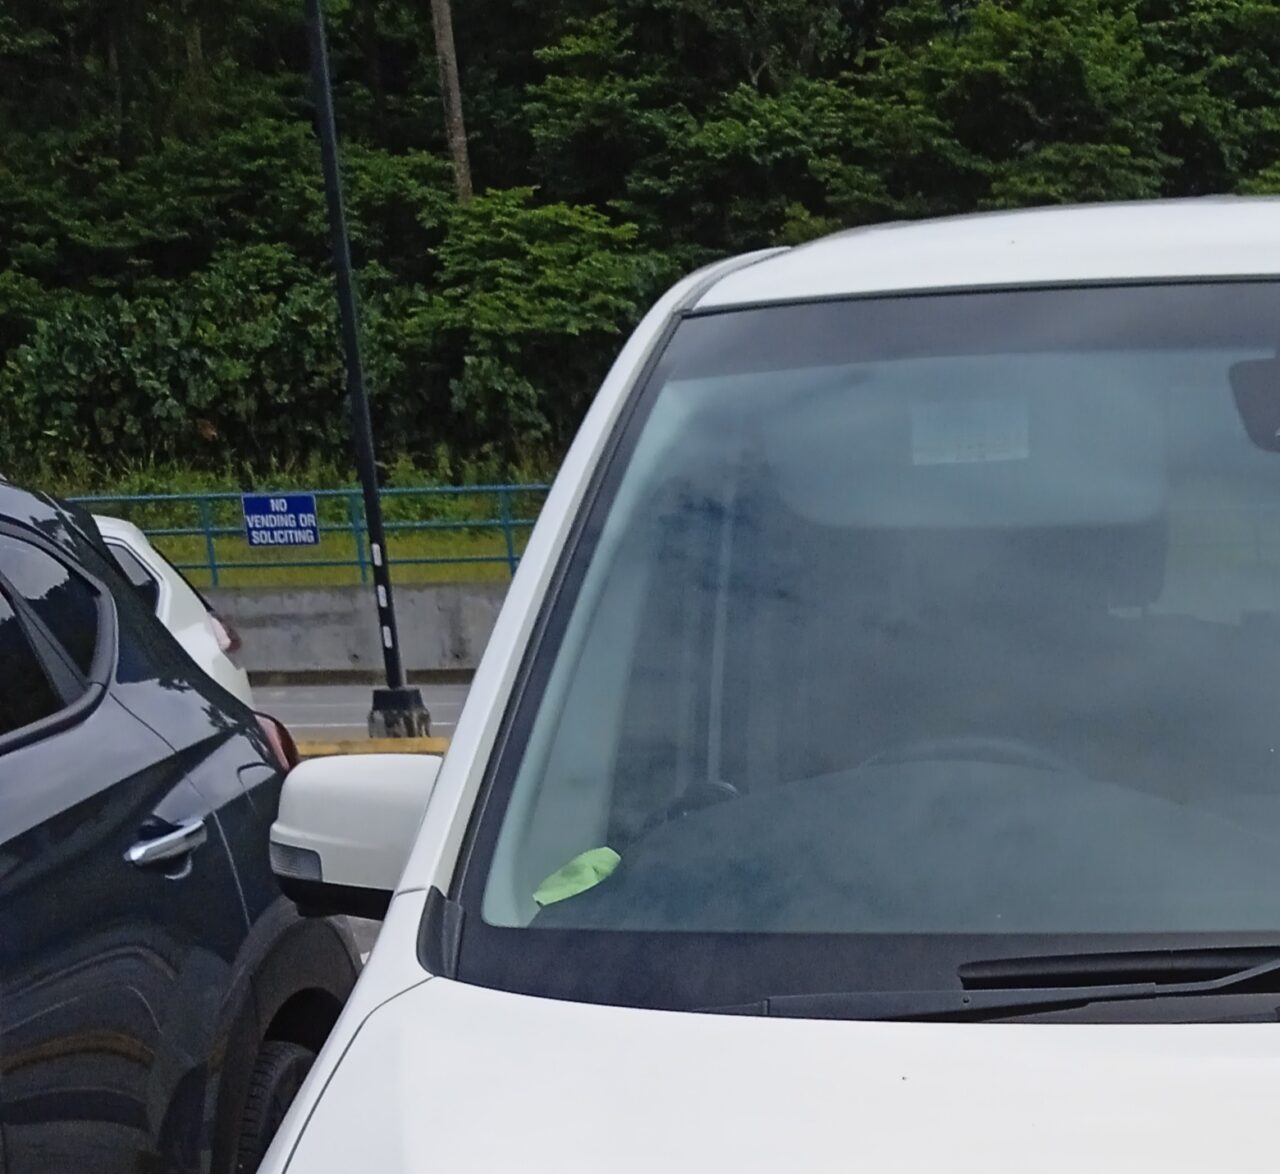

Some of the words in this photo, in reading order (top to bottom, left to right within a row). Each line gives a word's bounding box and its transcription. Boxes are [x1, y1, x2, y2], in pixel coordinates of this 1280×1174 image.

[270, 498, 288, 512] NO
[246, 514, 296, 528] VENDING
[298, 513, 316, 527] OR
[251, 529, 315, 544] SOLICITING
